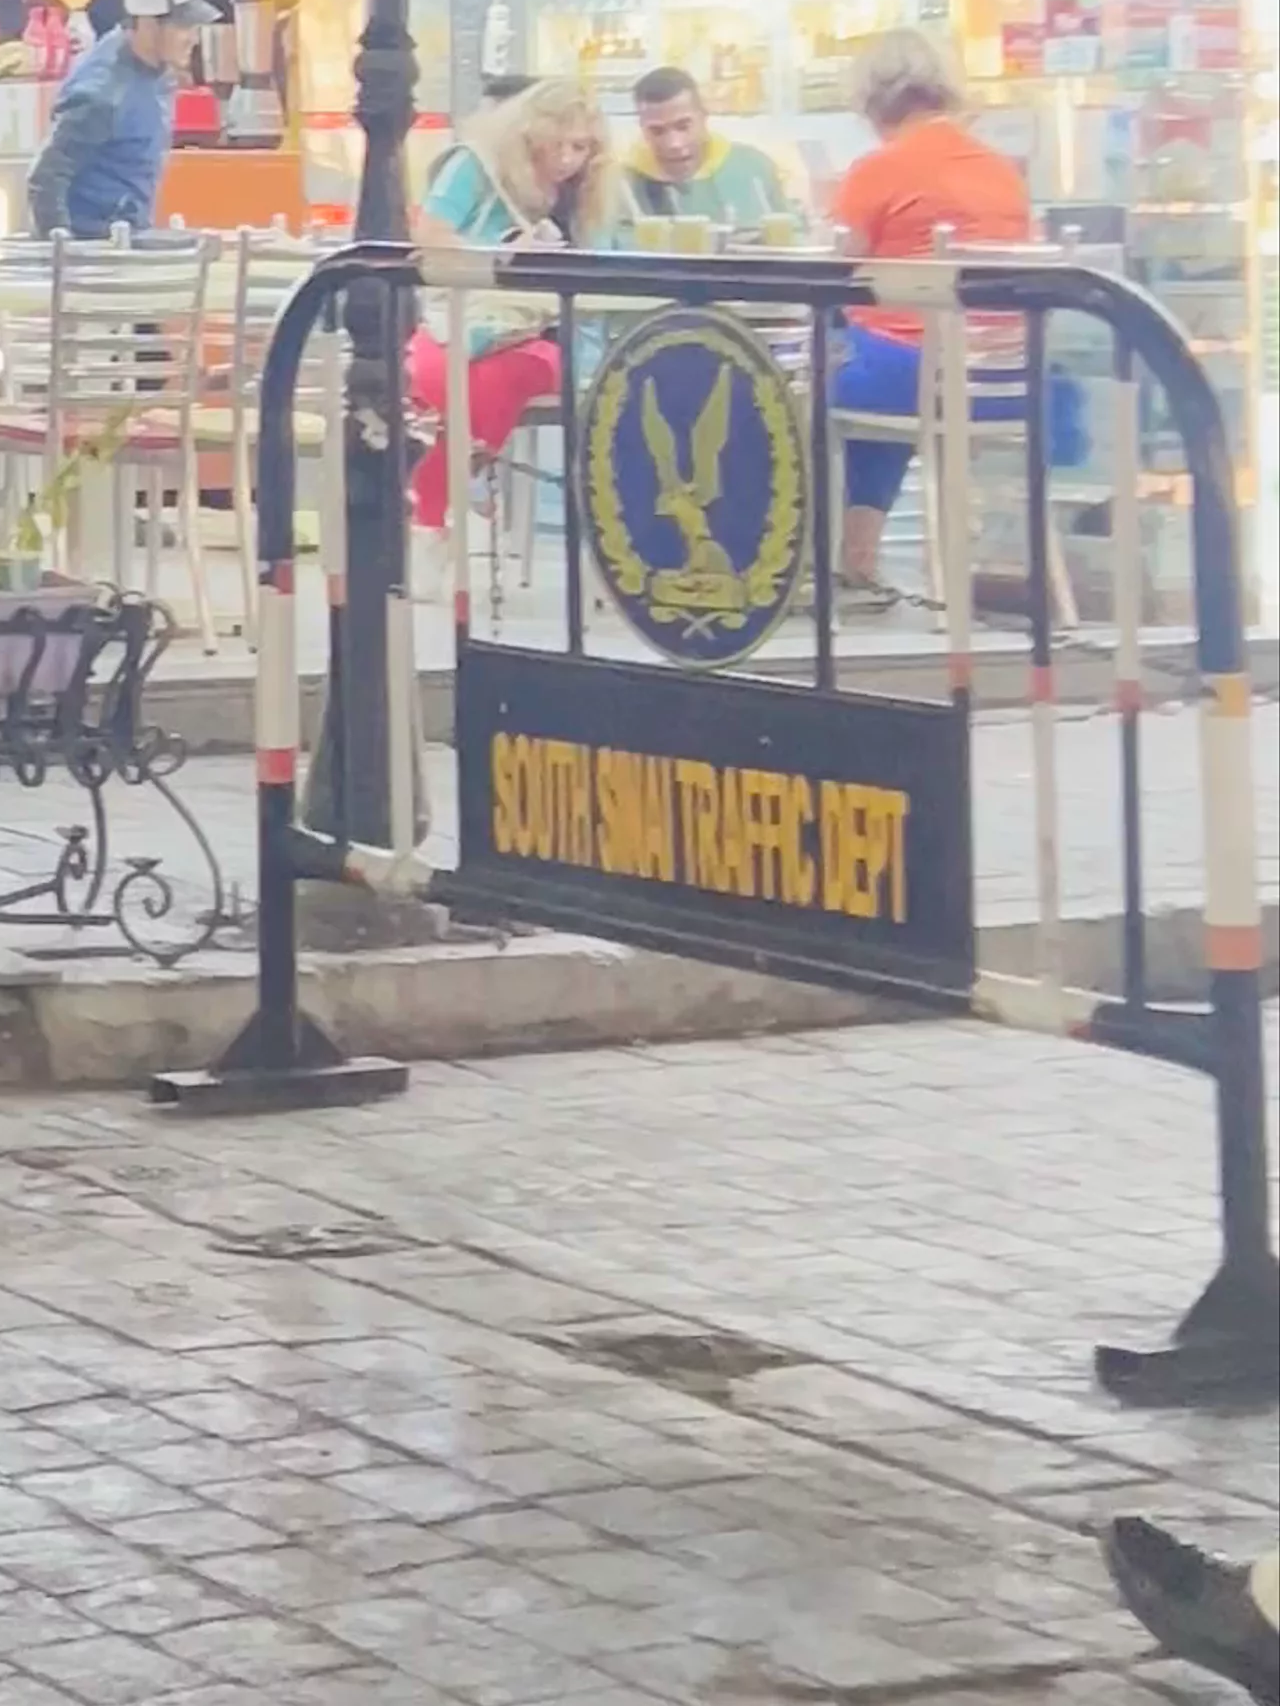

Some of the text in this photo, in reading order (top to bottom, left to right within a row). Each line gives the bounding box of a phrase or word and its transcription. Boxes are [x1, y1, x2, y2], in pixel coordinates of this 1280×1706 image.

[493, 732, 910, 924] SOUTH SINAI TRAFFIC DEPT
